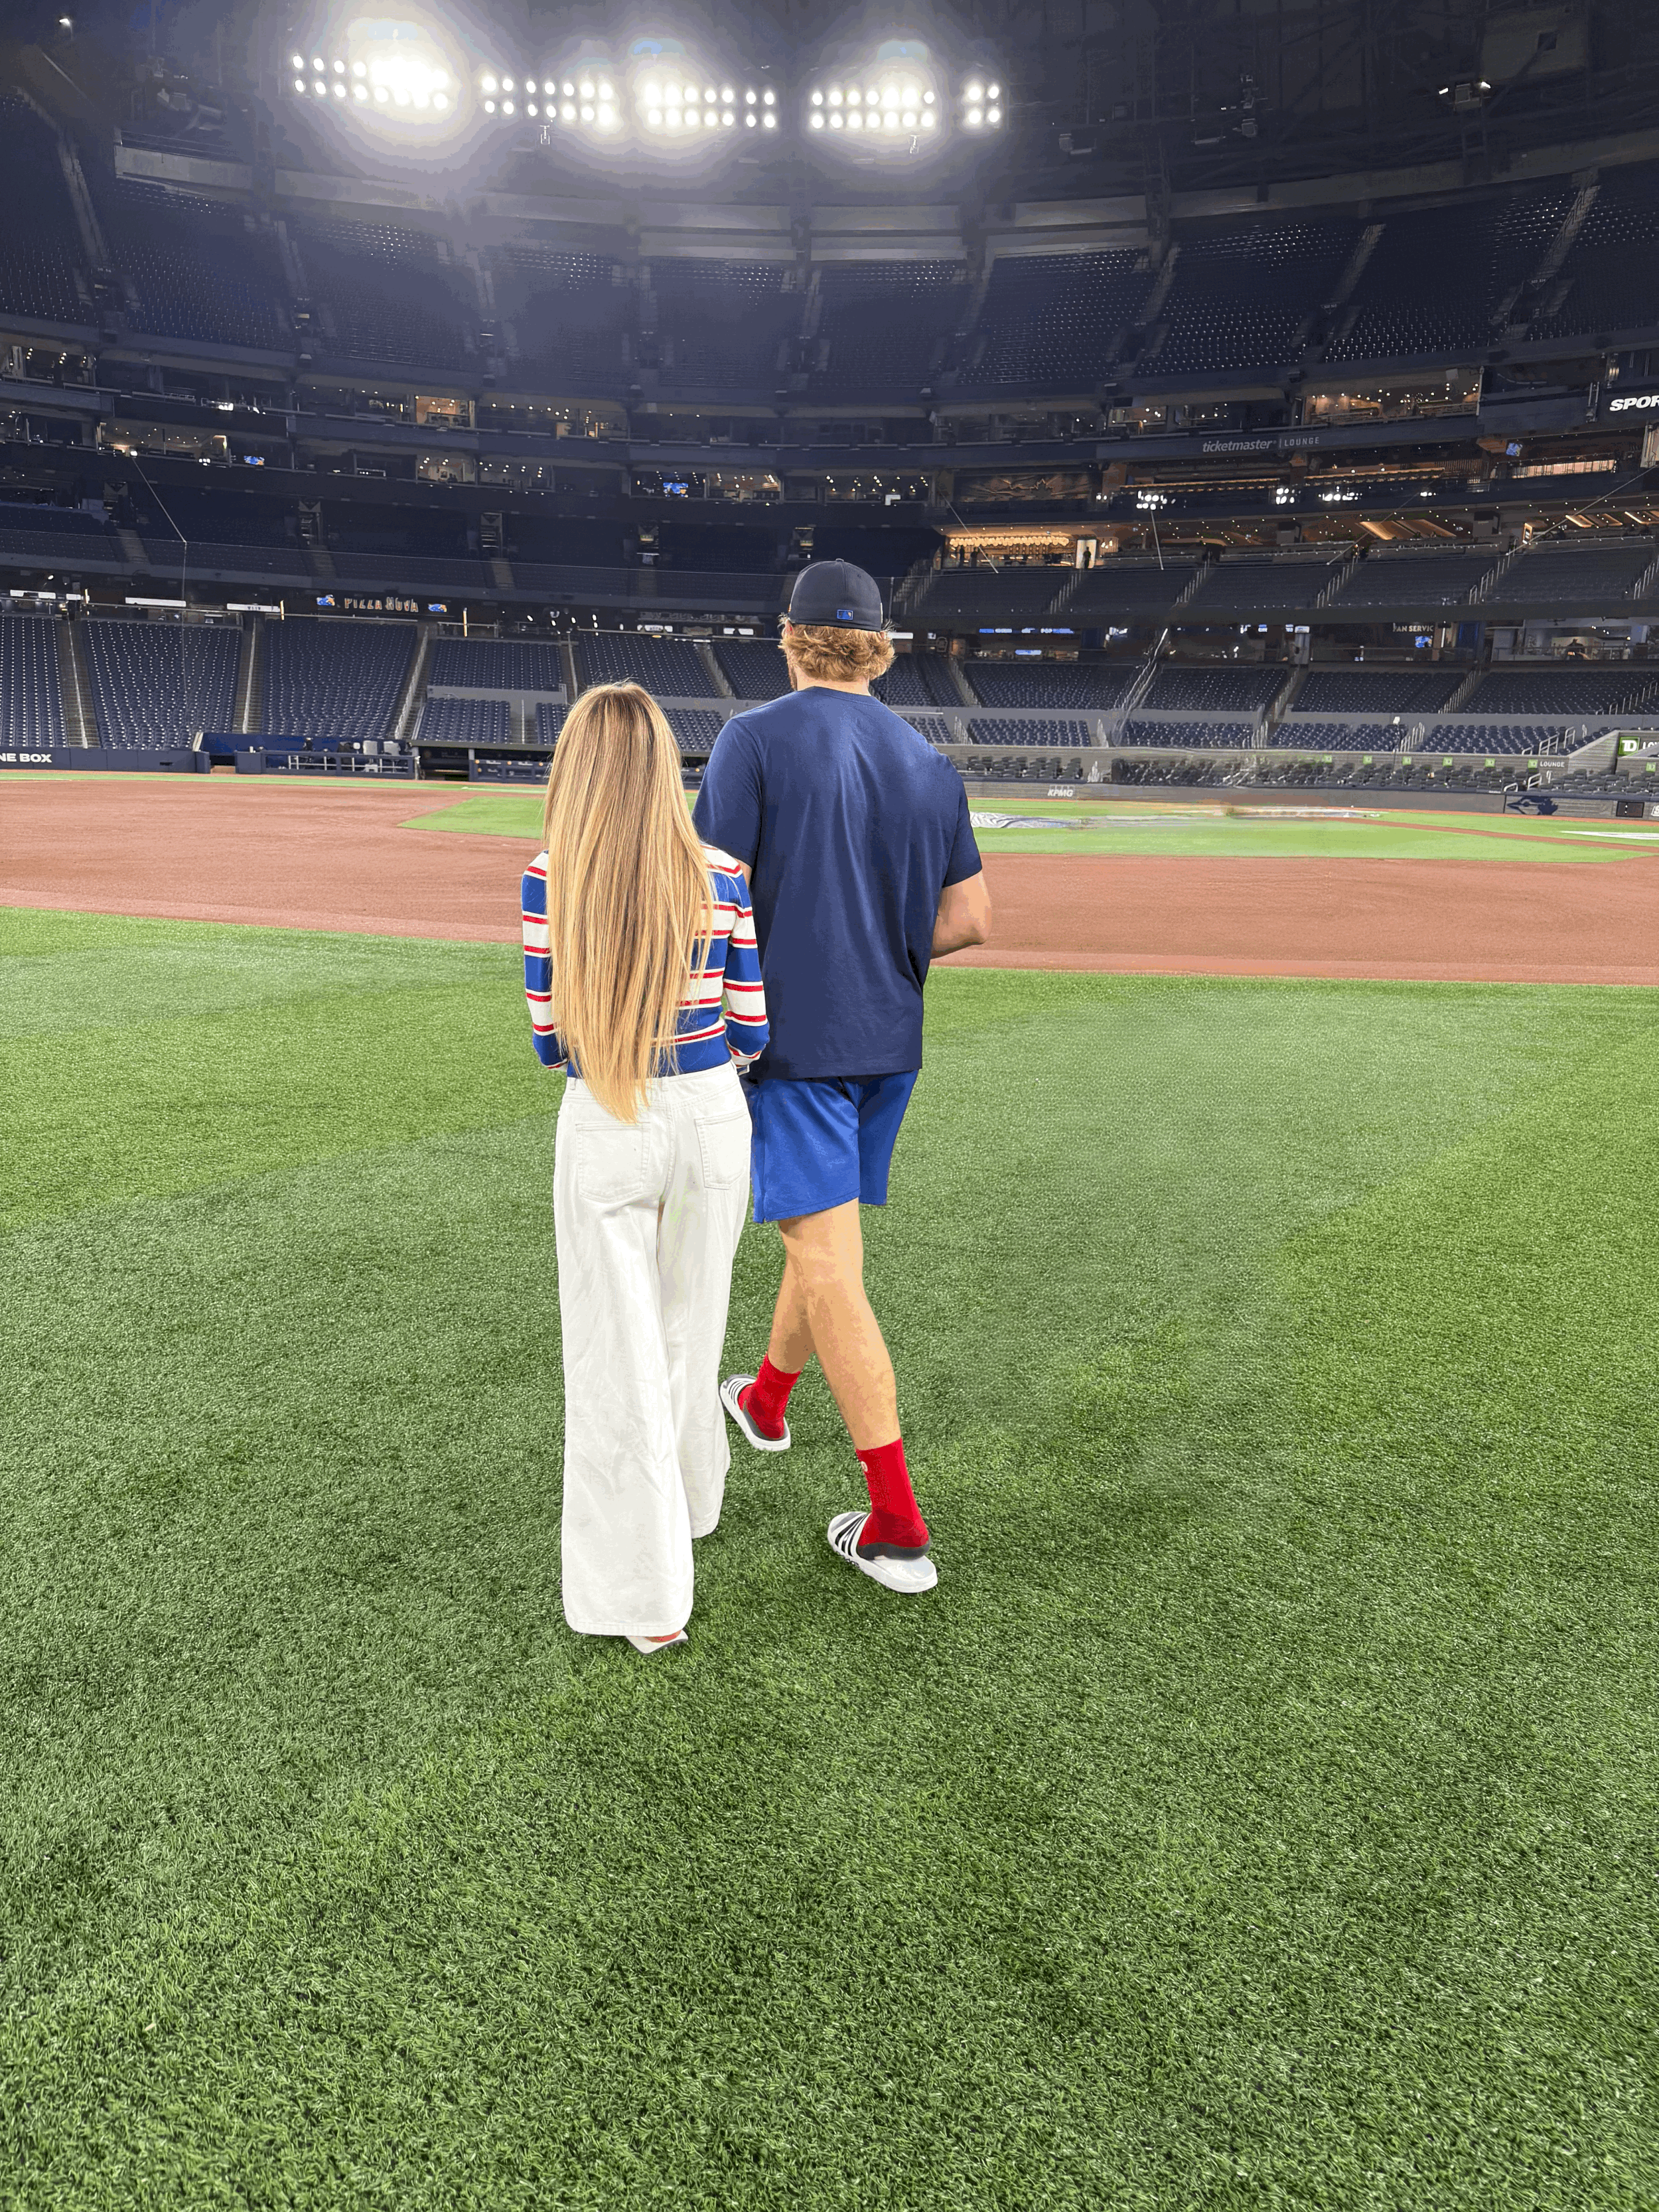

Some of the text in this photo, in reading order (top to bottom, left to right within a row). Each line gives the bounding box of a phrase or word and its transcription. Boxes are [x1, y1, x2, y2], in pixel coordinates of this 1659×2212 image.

[1609, 395, 1659, 411] SPOR
[1202, 437, 1320, 453] ticketmaster LOUNGE
[1622, 739, 1638, 752] TD
[19, 753, 52, 763] BOX
